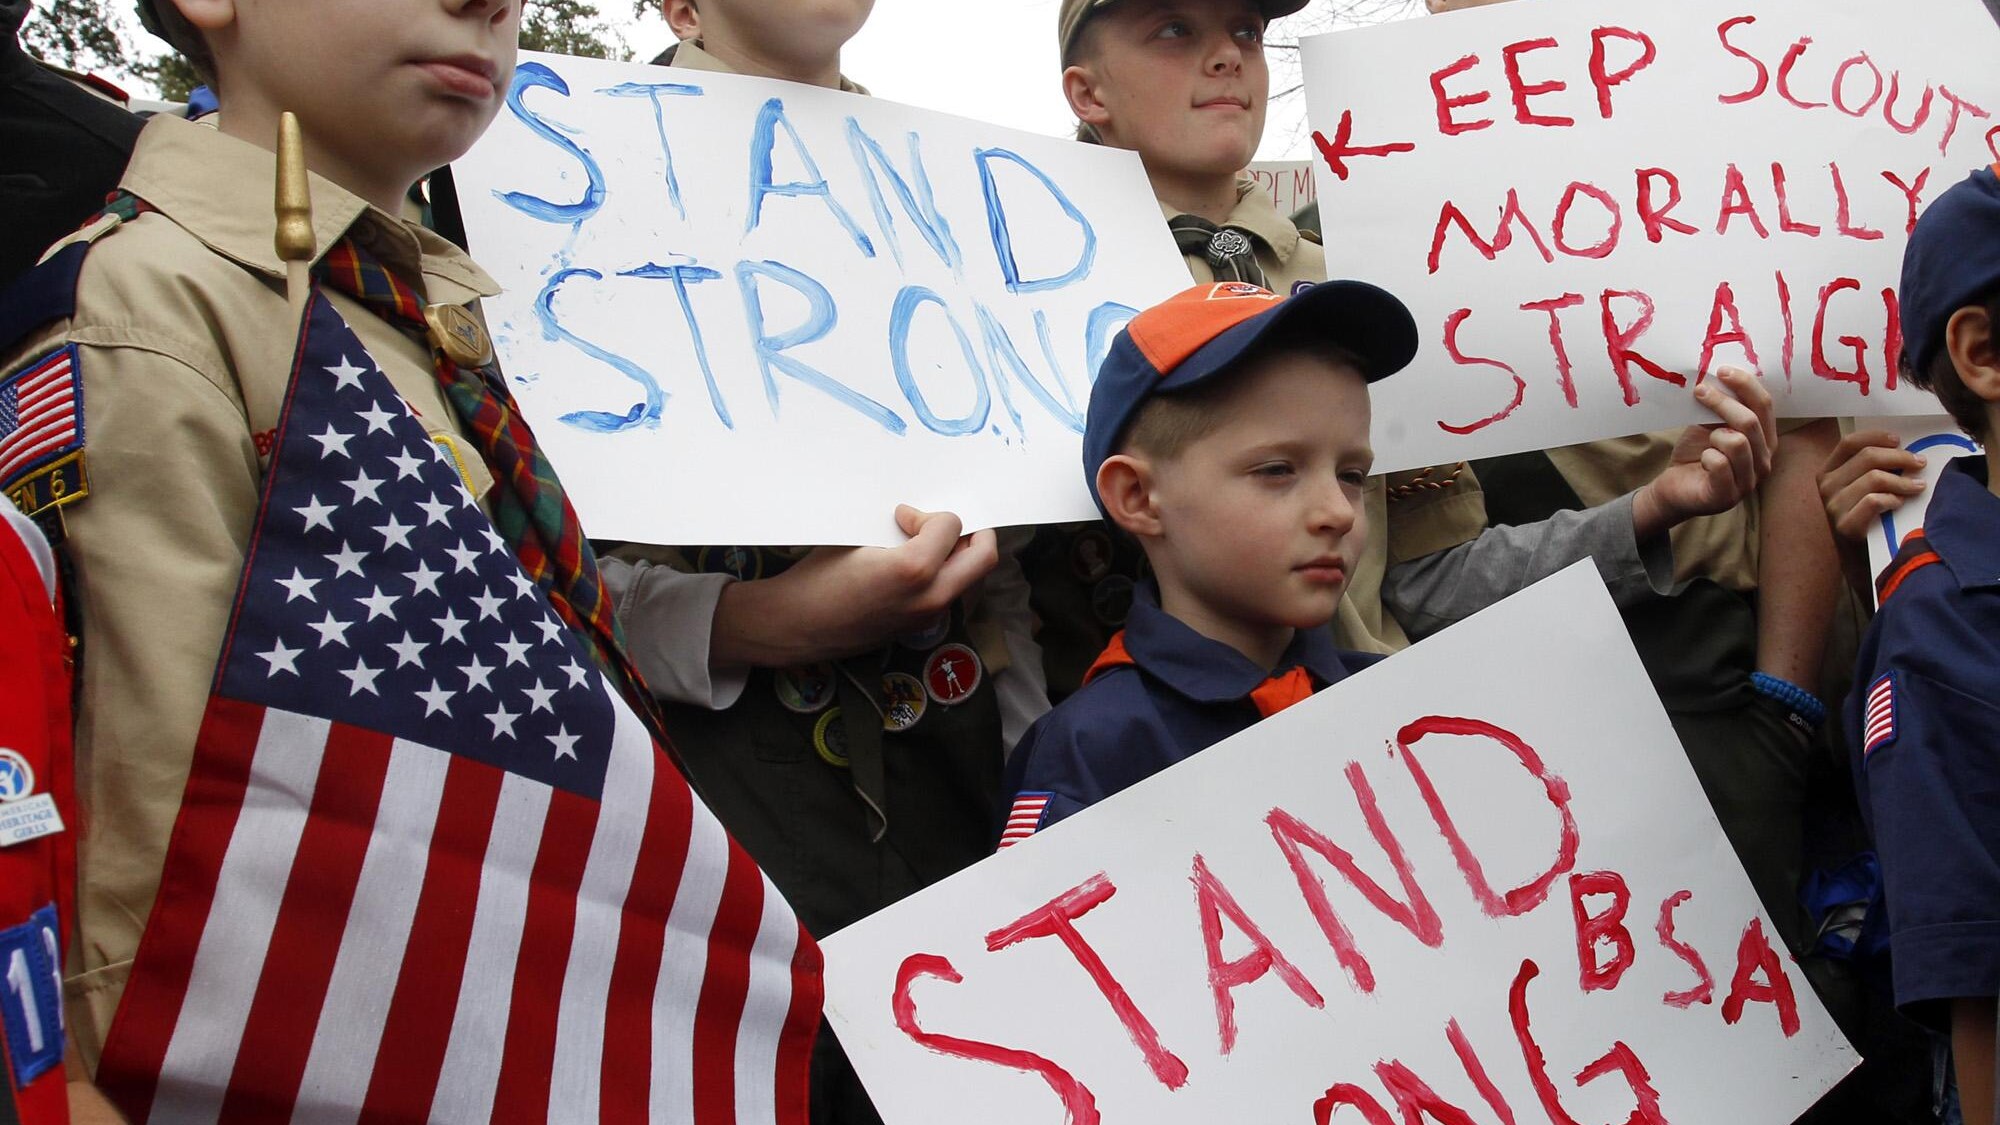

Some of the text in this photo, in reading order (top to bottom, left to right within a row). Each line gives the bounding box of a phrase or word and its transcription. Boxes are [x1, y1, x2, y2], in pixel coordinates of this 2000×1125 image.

[491, 61, 1097, 294] STAND
[1428, 162, 1931, 273] MORALLY
[50, 469, 65, 499] 6
[892, 715, 1579, 1125] STAND
[1569, 869, 1801, 1038] BSA
